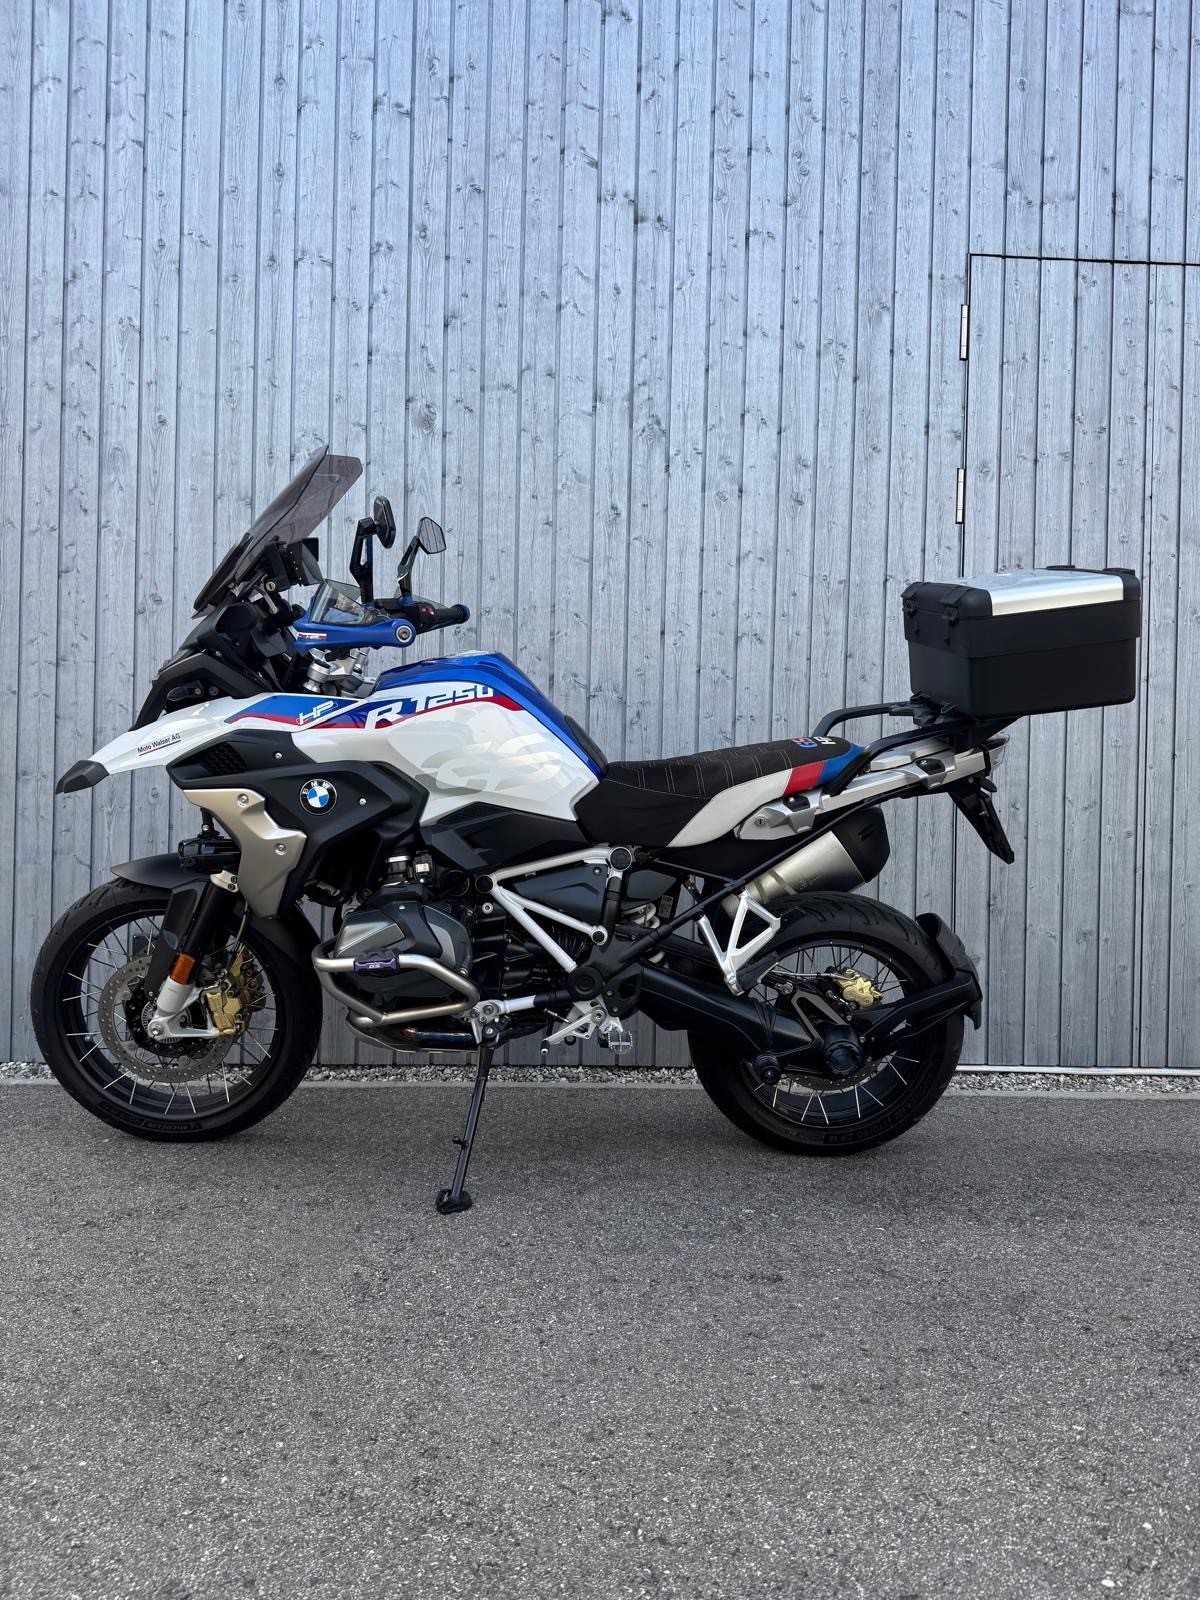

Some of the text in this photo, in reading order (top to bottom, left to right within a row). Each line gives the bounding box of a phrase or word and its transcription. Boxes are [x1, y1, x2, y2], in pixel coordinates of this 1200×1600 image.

[411, 685, 494, 713] 1250
[299, 700, 334, 725] HP
[137, 733, 181, 753] Moto Walser AG
[302, 780, 331, 795] BMW
